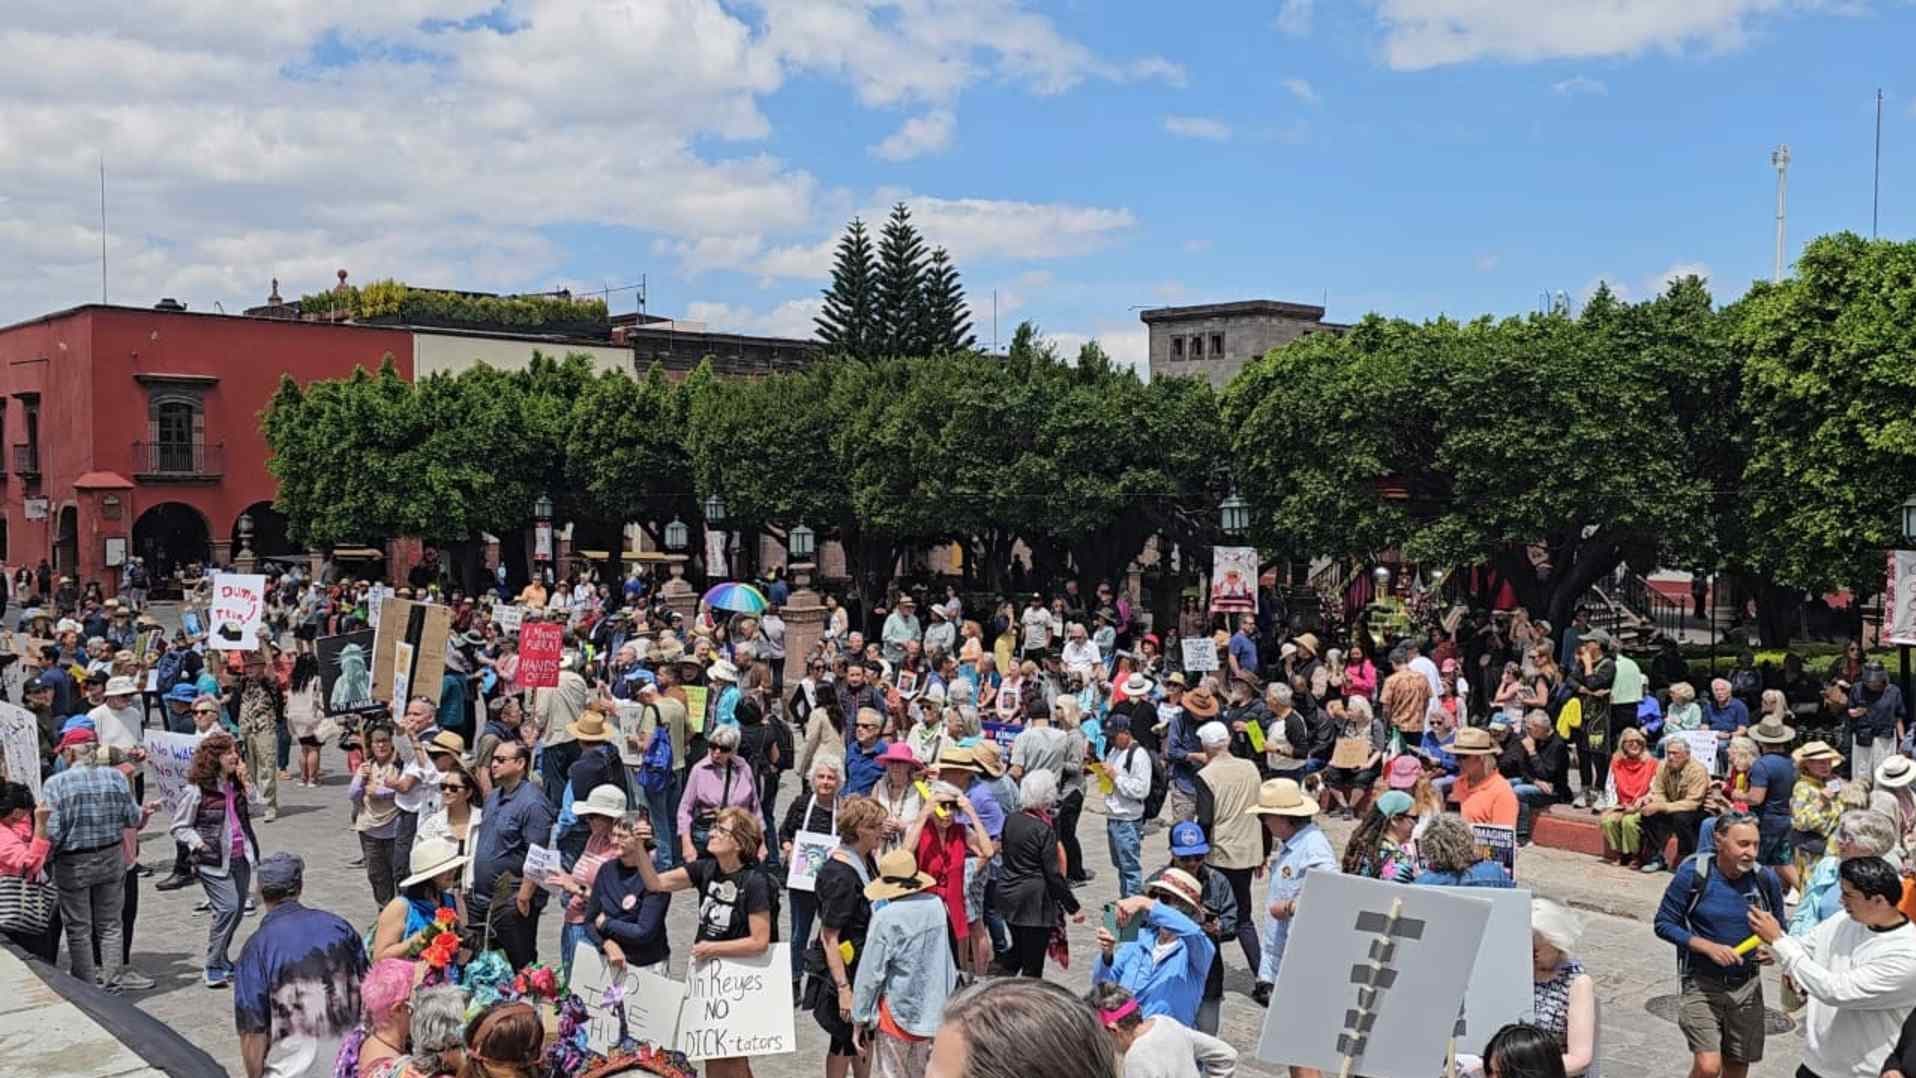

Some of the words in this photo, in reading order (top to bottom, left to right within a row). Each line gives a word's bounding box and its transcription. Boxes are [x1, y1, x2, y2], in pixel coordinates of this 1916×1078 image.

[521, 658, 558, 673] HANDS
[710, 958, 763, 1002] Reyes
[584, 985, 649, 1029] IE
[704, 998, 729, 1021] NO
[686, 1028, 783, 1057] DICK-tators
